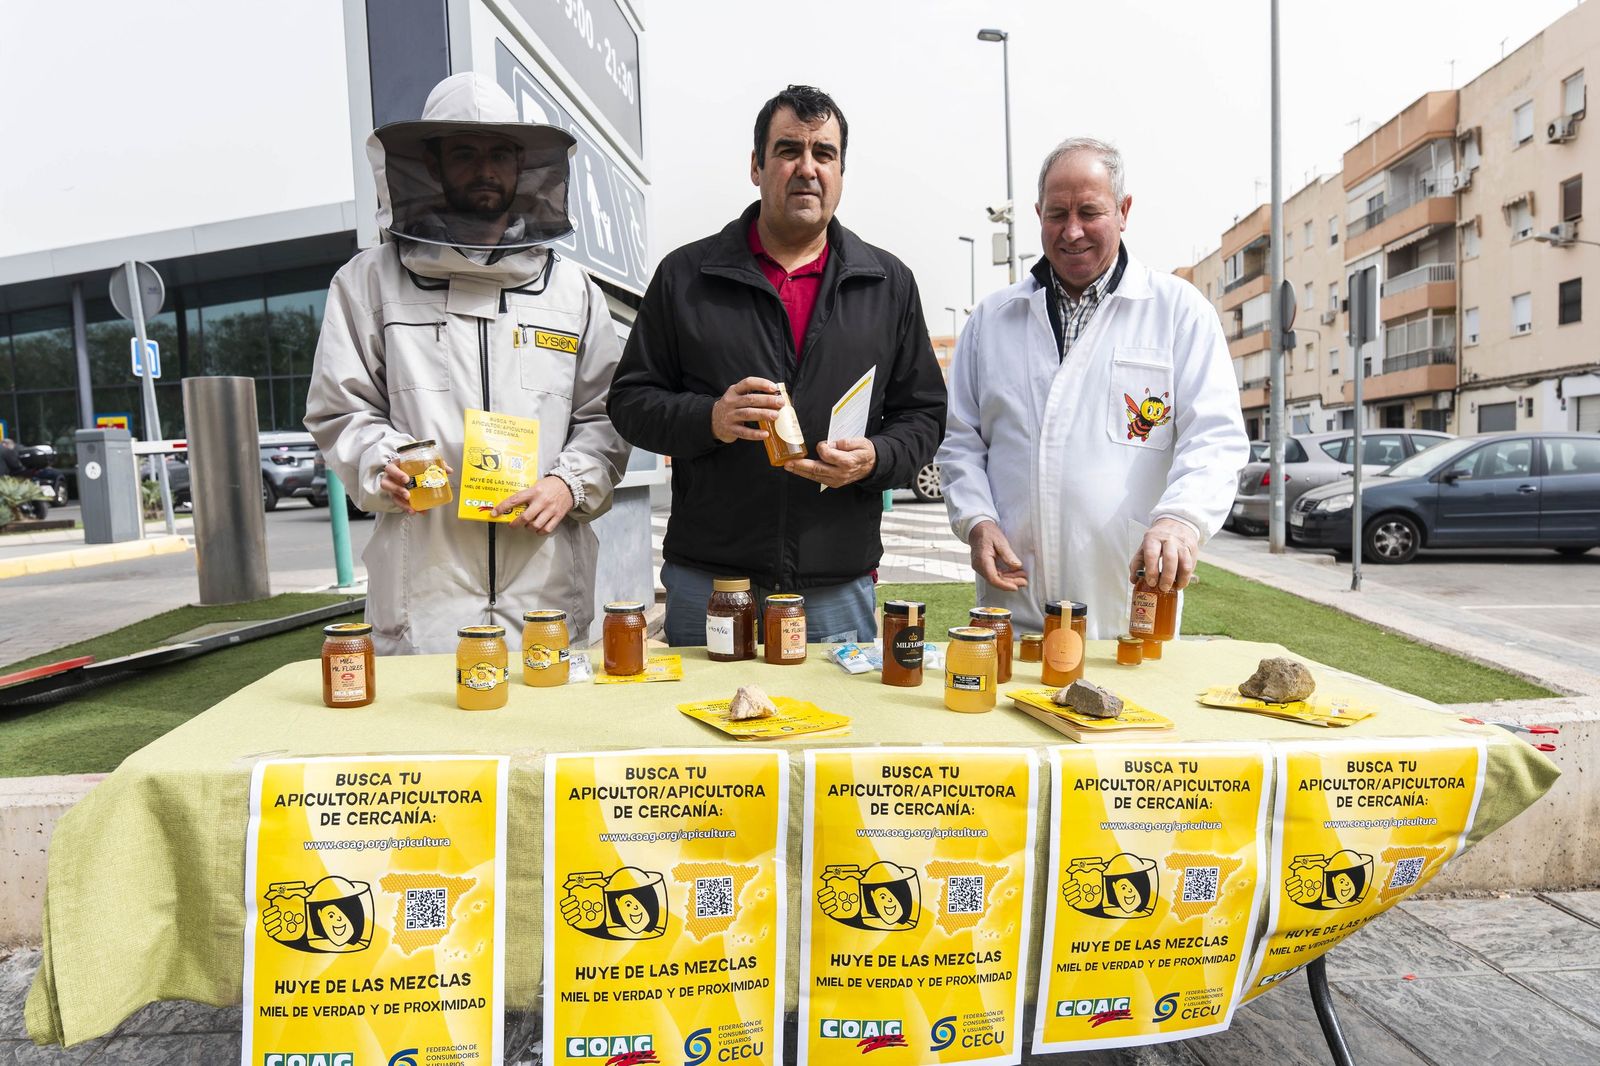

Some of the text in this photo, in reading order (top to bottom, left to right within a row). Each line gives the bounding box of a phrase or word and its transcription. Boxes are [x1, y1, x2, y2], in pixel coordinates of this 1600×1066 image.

[604, 37, 634, 105] 21:30
[537, 334, 577, 351] LYSON
[341, 664, 364, 672] FLORES
[626, 767, 706, 780] BUSCA TU
[882, 766, 959, 778] BUSCA TU
[1125, 761, 1197, 773] BUSCA TU
[1348, 761, 1416, 772] BUSCA TU
[336, 773, 421, 786] BUSCA TU
[1074, 779, 1250, 791] APICULTOR/APICULTORA
[1299, 777, 1464, 793] APICULTOR/APICULTORA
[569, 785, 765, 803] APICULTOR/APICULTORA
[828, 784, 1015, 797] APICULTOR/APICULTORA
[275, 790, 482, 809] APICULTOR/APICULTORA
[1115, 794, 1212, 809] DE CERCANÍA:
[1337, 792, 1427, 807] DE CERCANÍA:
[614, 801, 722, 818] DE CERCANÍA:
[871, 800, 974, 815] DE CERCANÍA:
[321, 807, 435, 826] DE CERCANÍA:
[1323, 816, 1437, 829] www.coag.org/apicultura
[856, 827, 988, 839] www.coag.org/apicultura
[1100, 820, 1223, 832] www.coag.org/apicultura
[303, 836, 451, 851] www.coag.org/apicultura
[599, 829, 736, 843] www.coag.org/apicultura
[1285, 928, 1321, 939] HUYE
[1323, 925, 1340, 937] DE
[1339, 919, 1362, 932] LAS
[1072, 936, 1228, 953] HUYE DE LAS MEZCLAS
[1269, 947, 1290, 955] MIEL
[1294, 945, 1306, 953] DE
[831, 951, 1001, 967] HUYE DE LAS MEZCLAS
[1057, 963, 1081, 972] MIEL
[1085, 963, 1098, 971] DE
[1102, 960, 1144, 970] VERDAD
[1159, 959, 1171, 967] DE
[1174, 954, 1235, 966] PROXIMIDAD
[576, 956, 756, 980] HUYE DE LAS MEZCLAS
[275, 973, 470, 994] HUYE DE LAS MEZCLAS
[817, 971, 1012, 988] MIEL DE VERDAD Y DE PROXIMIDAD
[561, 978, 769, 1002] MIEL DE VERDAD Y DE PROXIMIDAD
[1184, 993, 1224, 1001] CONSUMIDORES
[260, 998, 485, 1017] MIEL DE VERDAD Y DE PROXIMIDAD
[1058, 998, 1129, 1016] COAG
[1181, 1004, 1221, 1020] CECU
[963, 1011, 997, 1019] FEDERACIÓN
[963, 1016, 1005, 1027] CONSUMIDORES
[718, 1021, 754, 1031] FEDERACIÓN
[718, 1027, 764, 1039] CONSUMIDORES
[822, 1020, 901, 1038] COAG
[568, 1036, 651, 1056] COAG
[723, 1036, 752, 1045] USUARIOS
[962, 1030, 1005, 1048] CECU
[426, 1044, 468, 1053] FEDERACIÓN
[718, 1041, 764, 1062] CECU
[425, 1052, 480, 1061] CONSUMIDORES
